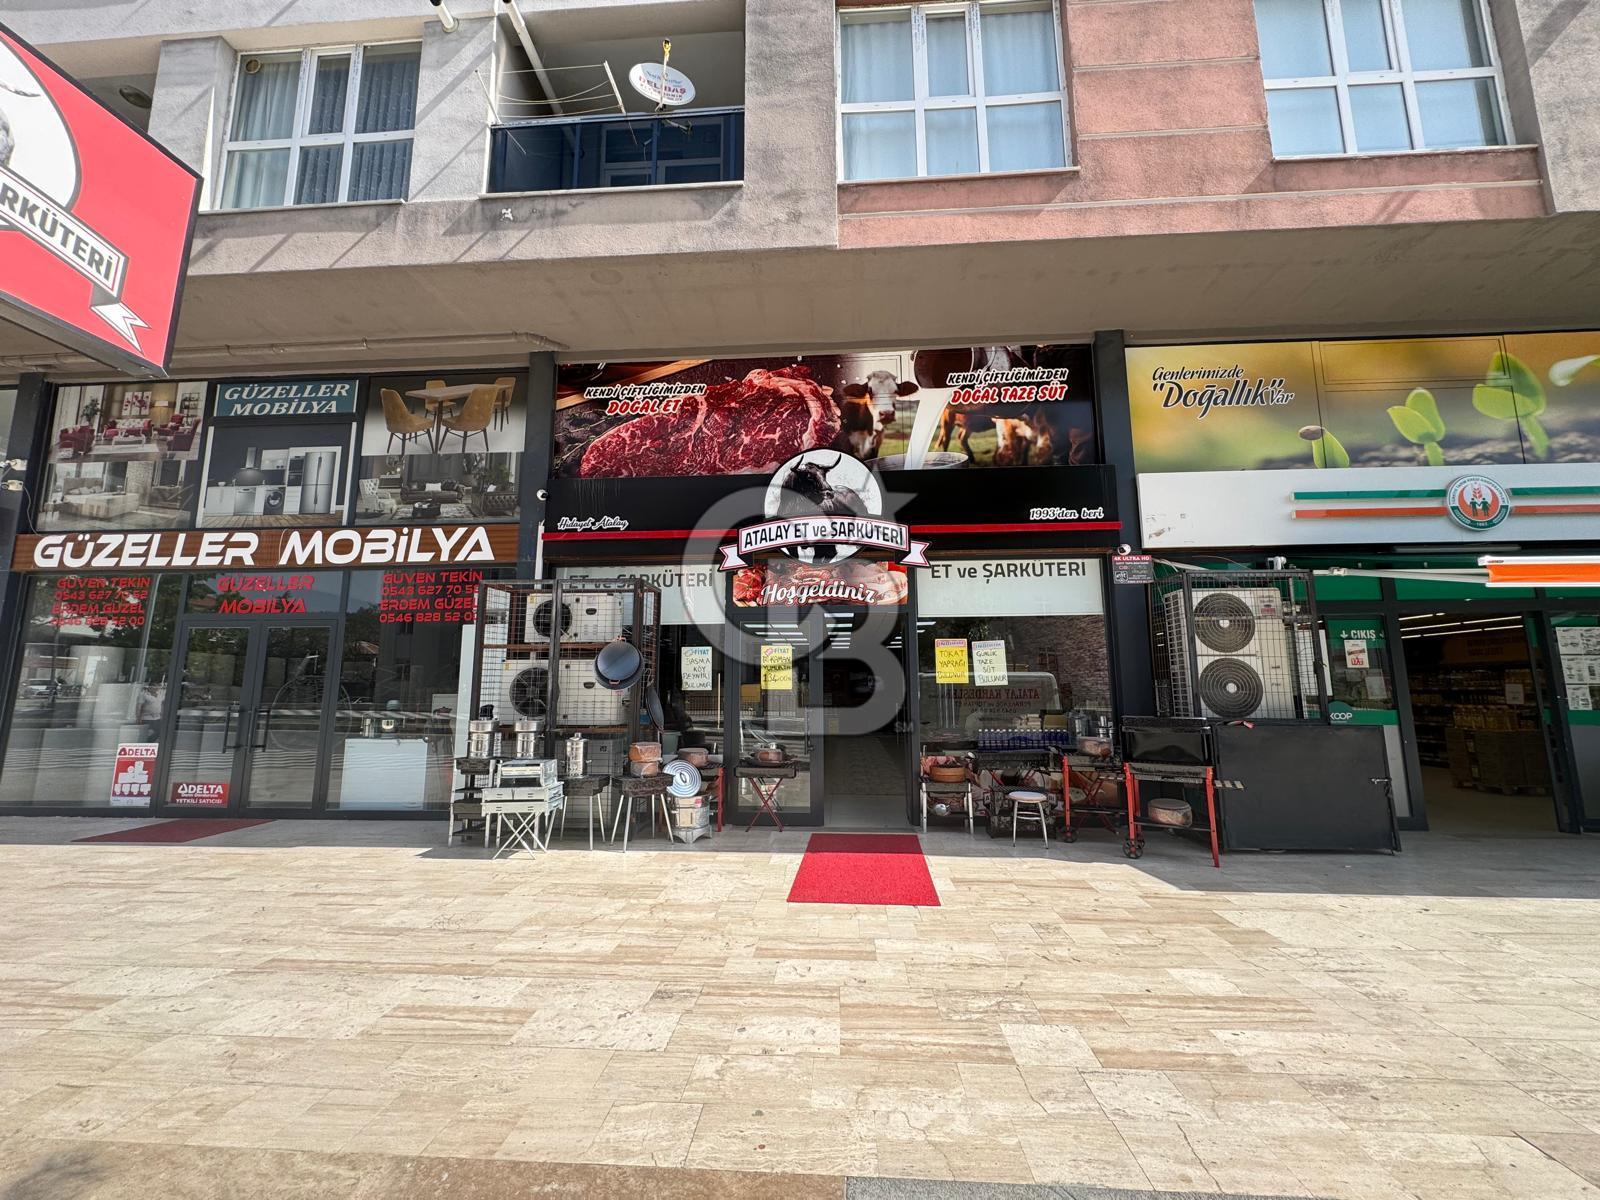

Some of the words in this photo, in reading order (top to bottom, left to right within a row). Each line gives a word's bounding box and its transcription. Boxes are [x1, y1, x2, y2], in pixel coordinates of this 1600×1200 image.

[947, 370, 981, 385] KENDİ
[982, 366, 1068, 386] ÇİFTLİĞİMİZDEN
[1152, 364, 1244, 381] Genlerimizde
[224, 383, 350, 400] GÜZELLER
[584, 383, 619, 399] KENDİ
[619, 382, 707, 400] ÇİFTLİĞİMİZDEN
[950, 385, 998, 404] DOĞAL
[1001, 386, 1036, 403] TAZE
[1037, 381, 1068, 401] SÜT
[1269, 389, 1295, 405] Var
[229, 399, 337, 416] MOBİLYA
[606, 396, 659, 415] DOĞAL
[661, 398, 682, 414] ET
[1030, 507, 1079, 520] 1993'den
[1081, 507, 1104, 519] beri
[558, 517, 592, 531] Hidayet
[594, 516, 629, 530] Atalay
[744, 524, 790, 549] ATALAY
[794, 523, 809, 537] ET
[812, 525, 827, 538] ve
[831, 521, 904, 546] ŞARKÜTERİ
[33, 533, 259, 568] GÜZELLER
[278, 526, 495, 565] MOBİLYA
[440, 569, 483, 582] TEKİN
[931, 564, 953, 579] ET
[957, 567, 978, 578] ve
[88, 590, 112, 600] 627
[381, 586, 415, 596] 0543
[418, 585, 442, 595] 627
[446, 584, 462, 594] 70
[761, 581, 876, 605] Hoşgeldiniz
[380, 599, 430, 611] ERDEM
[434, 595, 479, 609] GÜZEL
[129, 616, 145, 625] 00
[379, 613, 412, 624] 0546
[415, 612, 441, 622] 828
[444, 612, 460, 621] 52
